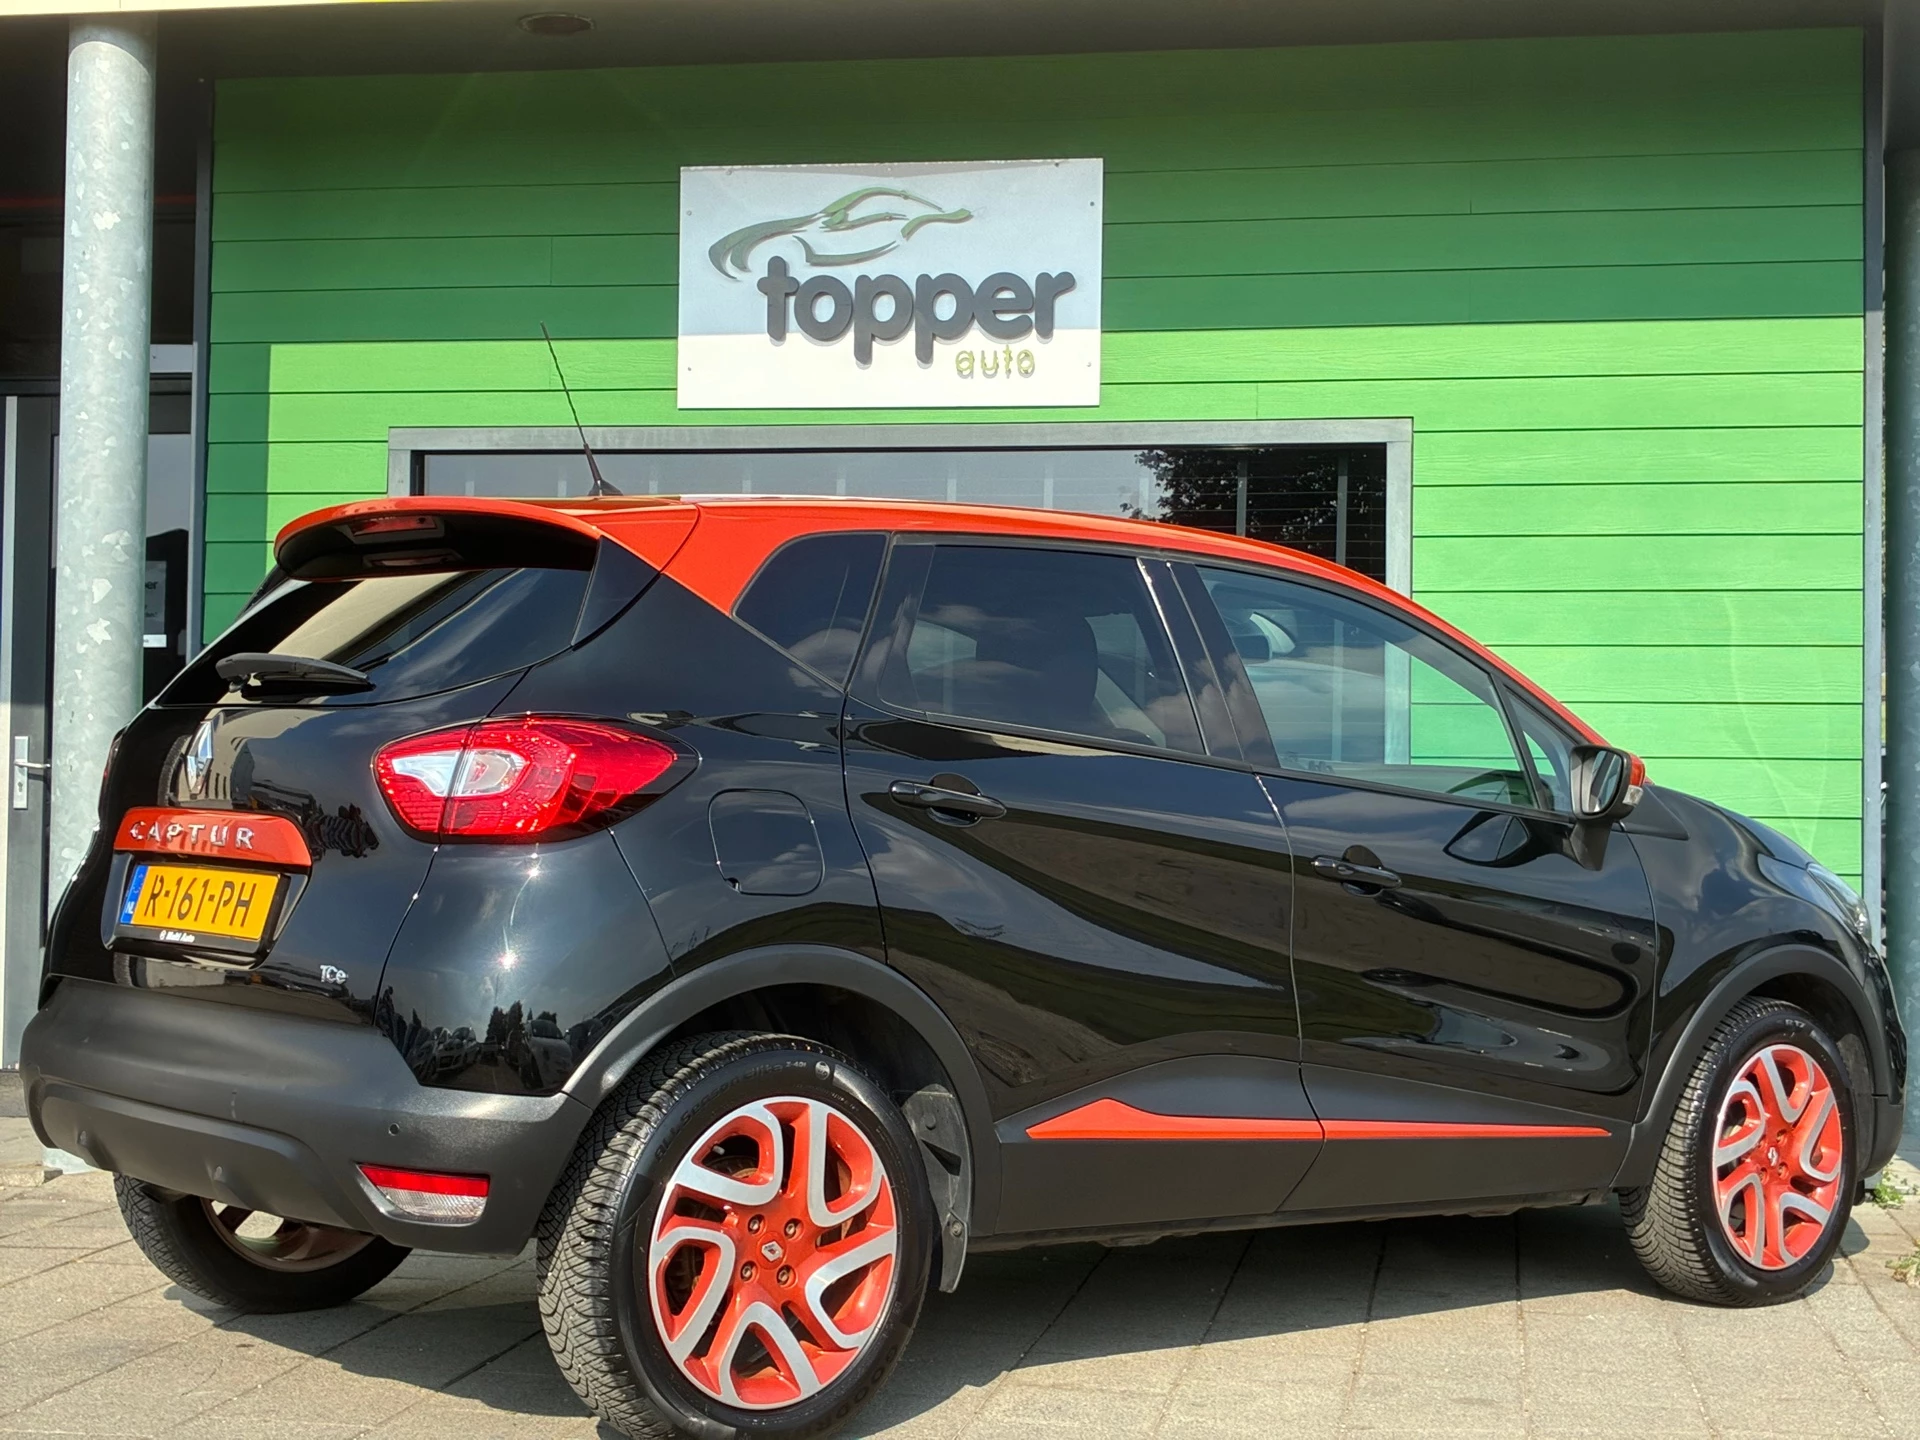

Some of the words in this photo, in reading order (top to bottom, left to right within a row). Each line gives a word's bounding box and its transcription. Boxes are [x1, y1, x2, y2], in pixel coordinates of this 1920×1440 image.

[757, 256, 1077, 366] topper
[955, 346, 1036, 376] auto
[130, 821, 254, 849] CAPTUR
[125, 901, 134, 914] NL
[144, 874, 258, 928] R-161-PH
[319, 964, 347, 985] TCe
